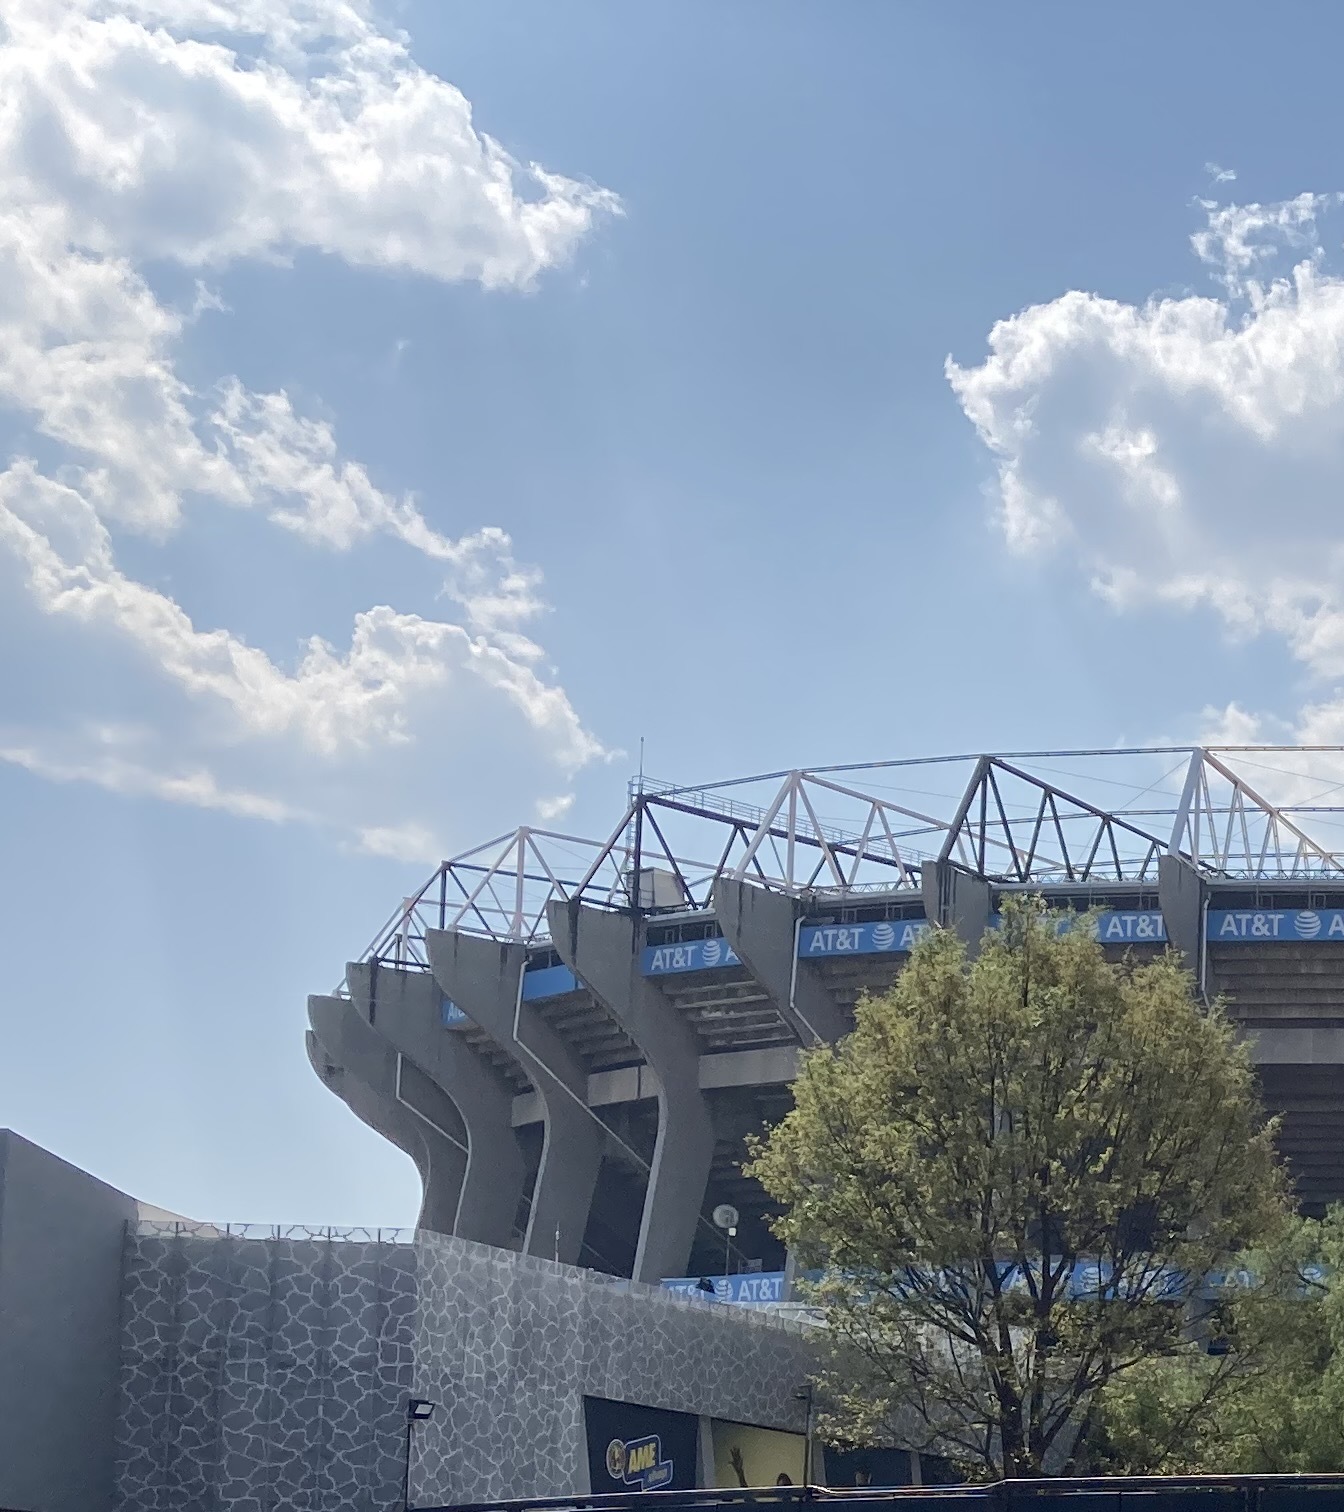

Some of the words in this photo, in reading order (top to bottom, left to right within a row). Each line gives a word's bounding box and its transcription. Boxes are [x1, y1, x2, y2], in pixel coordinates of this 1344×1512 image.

[1106, 914, 1163, 938] AT&T
[1219, 913, 1284, 937] AT&T
[810, 927, 865, 952] AT&T
[651, 945, 698, 971] AT&T
[738, 1278, 783, 1301] AT&T
